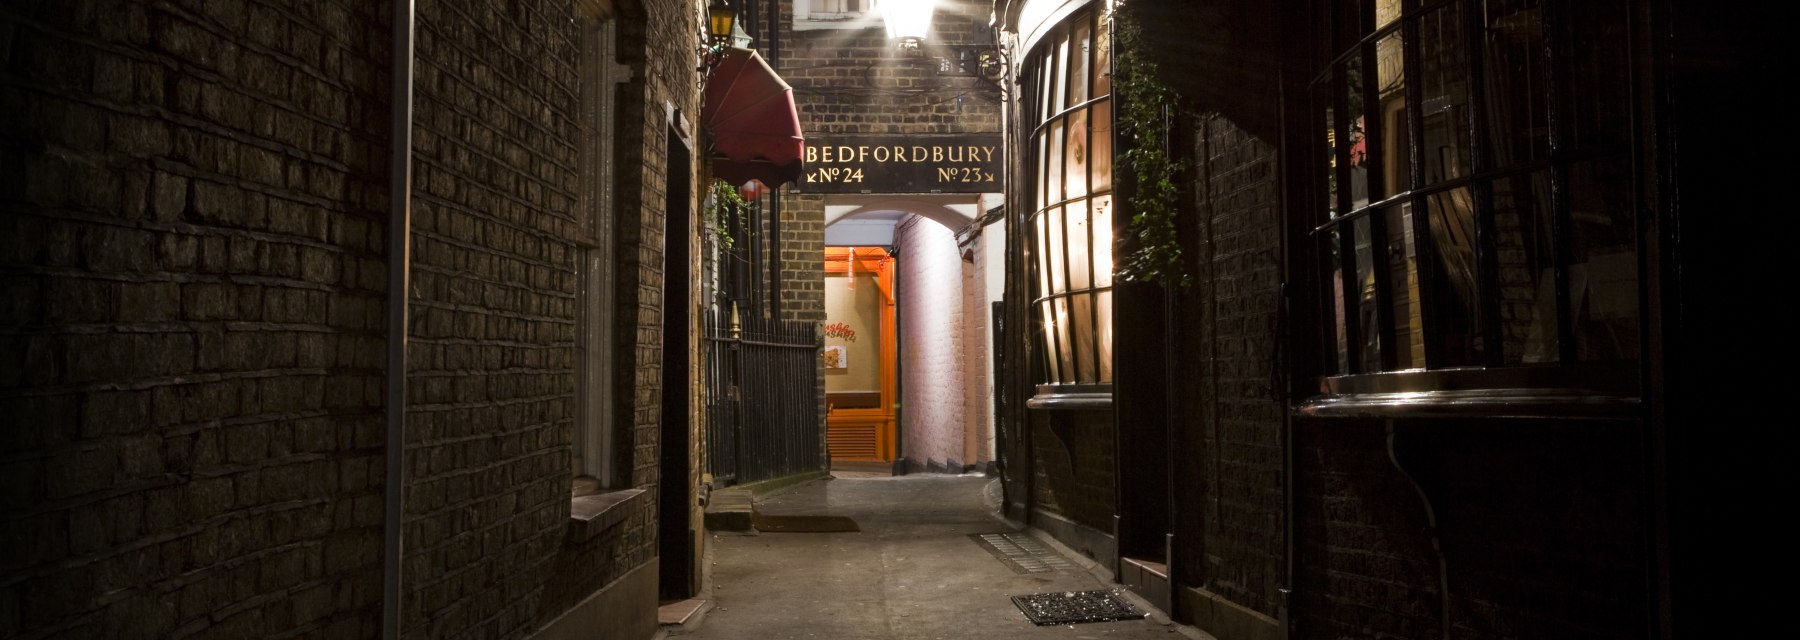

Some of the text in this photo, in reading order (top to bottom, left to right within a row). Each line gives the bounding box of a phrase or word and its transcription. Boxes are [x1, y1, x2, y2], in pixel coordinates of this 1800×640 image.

[806, 146, 995, 162] BEDFORDBURY
[842, 168, 864, 182] 24
[961, 168, 982, 182] 23
